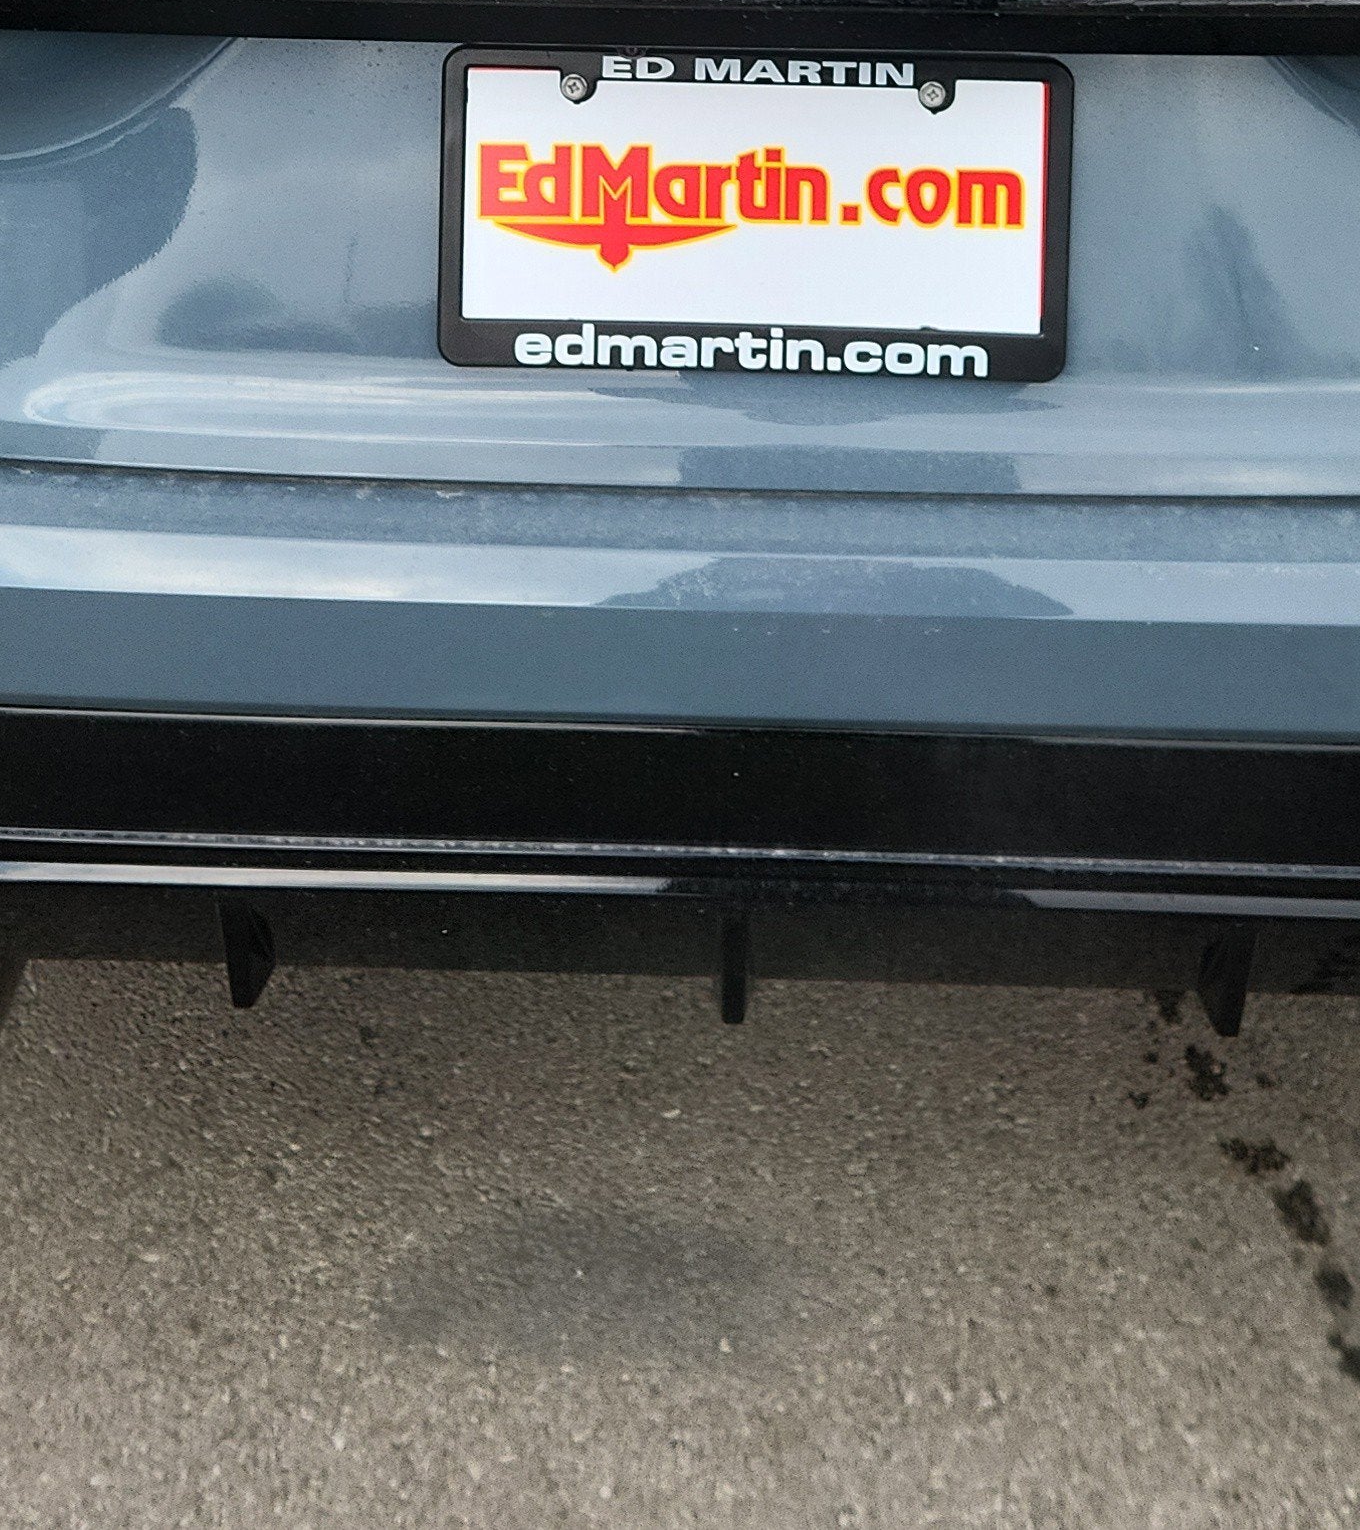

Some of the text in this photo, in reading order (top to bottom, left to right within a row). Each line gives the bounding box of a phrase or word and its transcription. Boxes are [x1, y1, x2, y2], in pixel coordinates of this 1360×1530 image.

[601, 55, 915, 87] ED MARTIN
[477, 143, 1027, 230] EdMartin.com
[514, 323, 990, 378] edmartin.com
